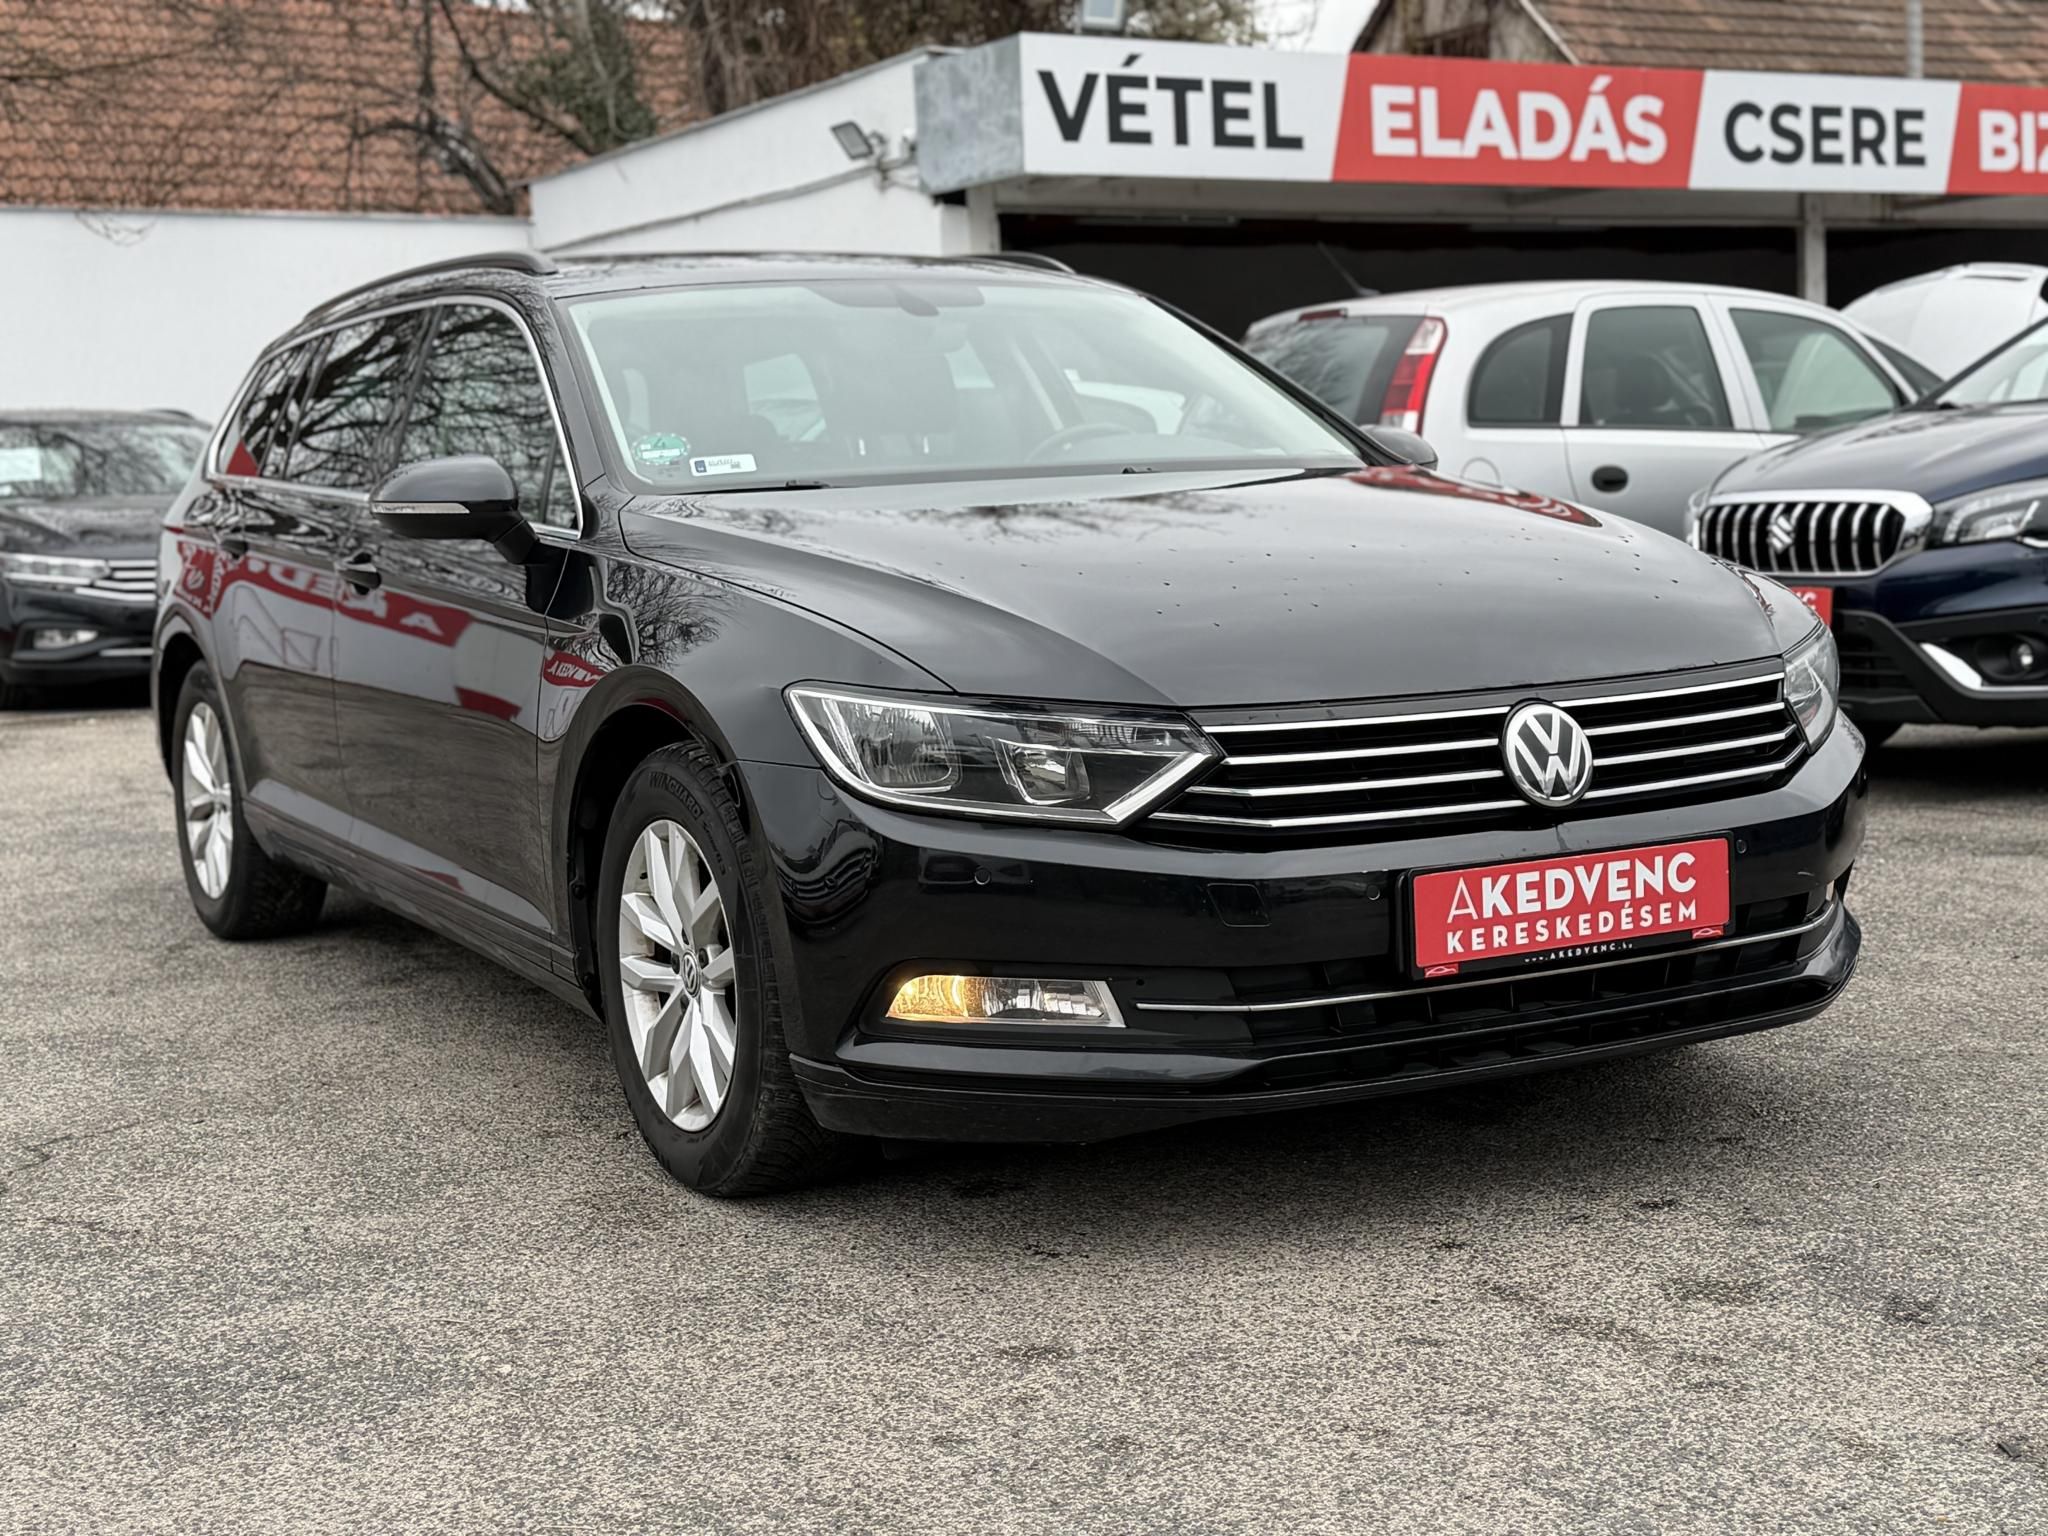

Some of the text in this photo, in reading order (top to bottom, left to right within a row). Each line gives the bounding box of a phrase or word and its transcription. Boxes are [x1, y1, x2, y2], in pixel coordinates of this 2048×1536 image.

[1038, 54, 1304, 150] VÉTEL
[1370, 74, 1668, 165] ELADÁS
[1724, 102, 1926, 167] CSERE
[1447, 899, 1697, 954] KERESKEDÉSEM
